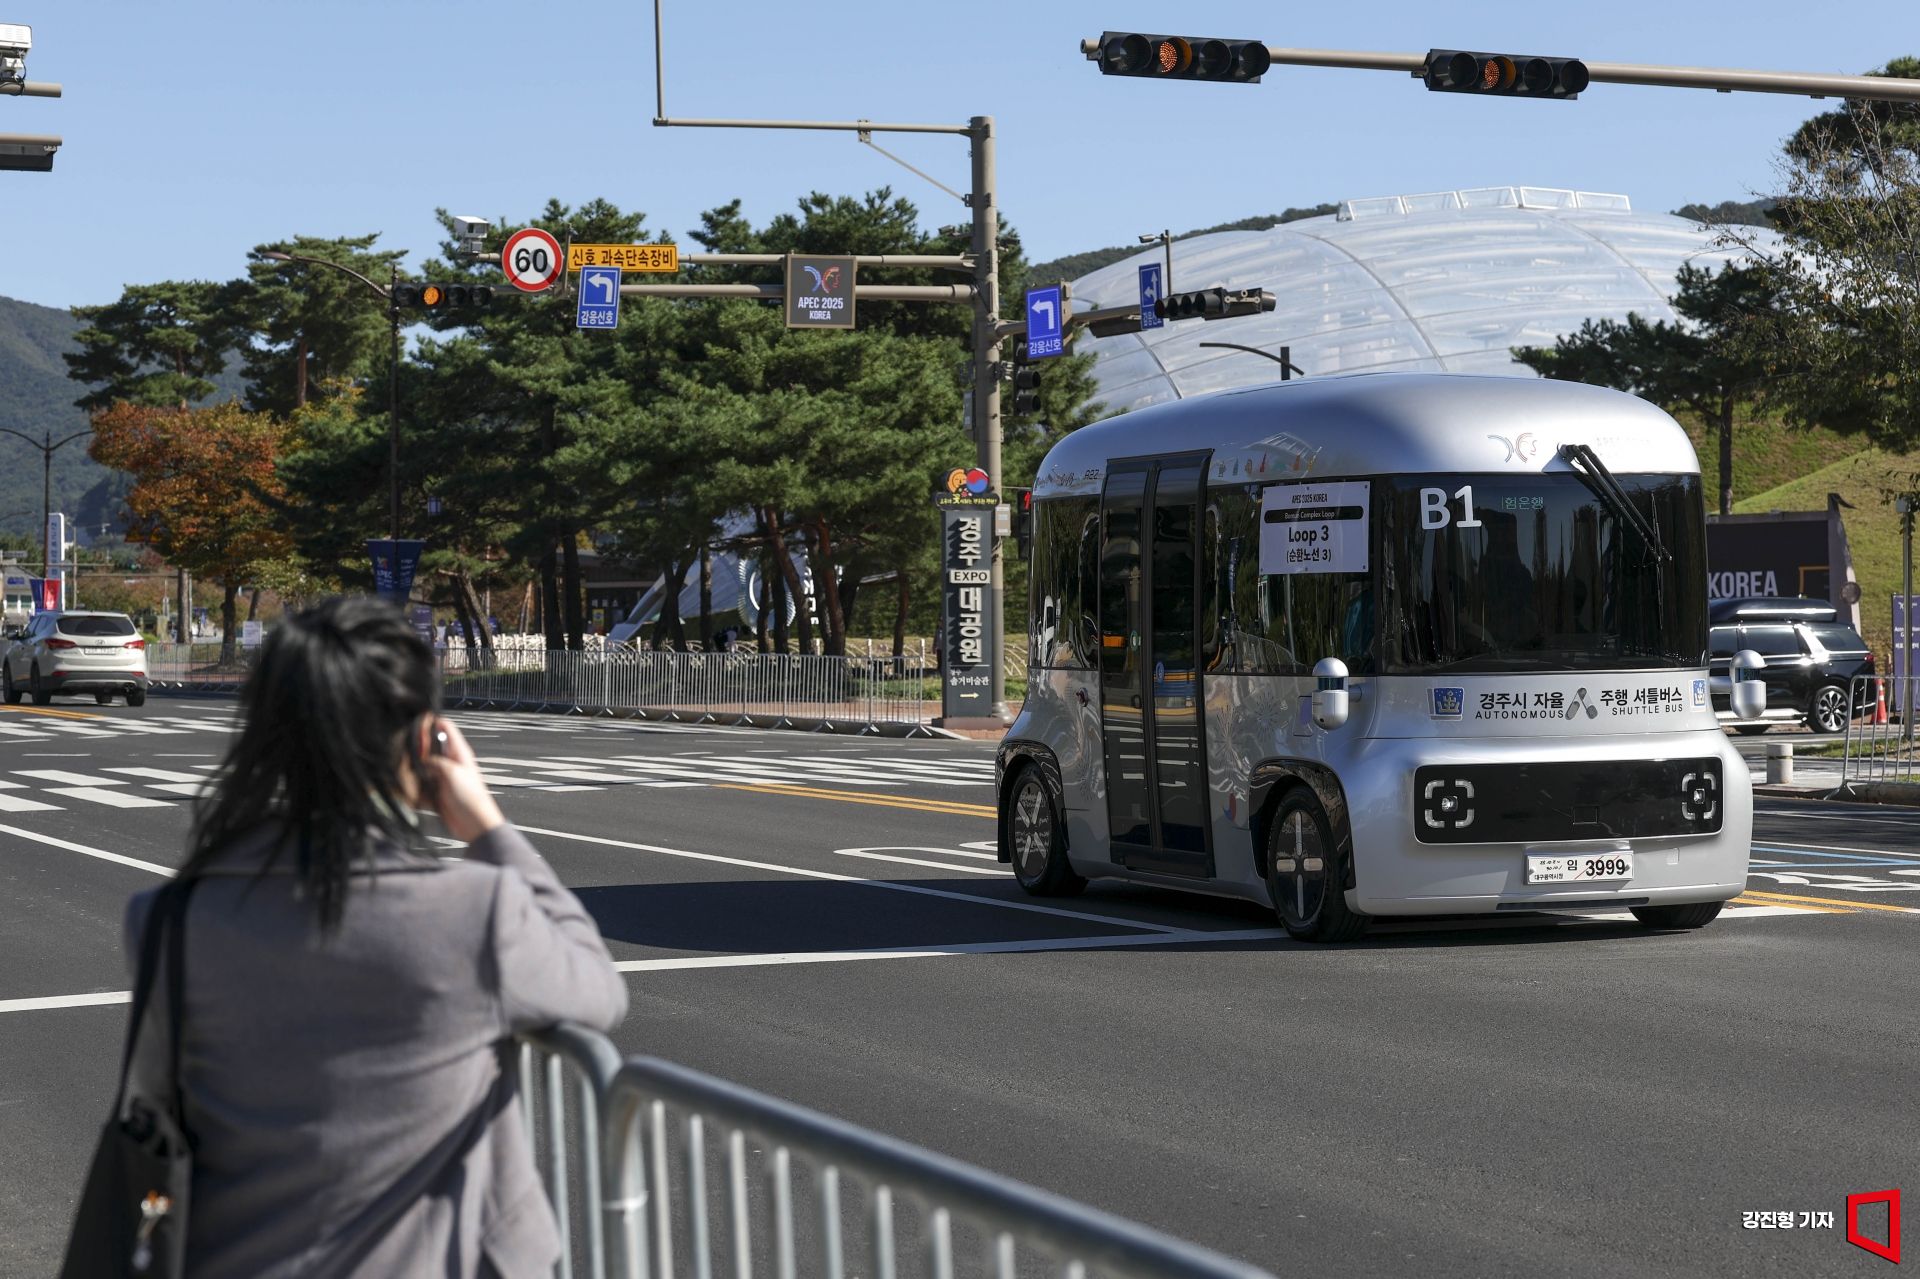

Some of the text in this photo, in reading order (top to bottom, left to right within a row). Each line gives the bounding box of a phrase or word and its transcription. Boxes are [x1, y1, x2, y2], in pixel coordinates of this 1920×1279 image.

[515, 248, 547, 272] 60
[573, 249, 673, 267] 신호 과속단속장비
[798, 297, 843, 309] APEC 2025
[581, 310, 613, 325] 감응신호
[809, 310, 831, 320] KOREA
[1030, 338, 1061, 354] 감응신호
[1313, 493, 1328, 503] KOREA
[1300, 509, 1321, 520] Complex
[1321, 510, 1335, 519] Loop
[1420, 485, 1482, 530] B1
[958, 517, 982, 566] 경주
[1288, 525, 1329, 547] Loop 3
[1286, 548, 1332, 563] (순환노선 3)
[954, 571, 987, 582] EXPO
[1708, 570, 1778, 598] KOREA
[959, 587, 982, 663] 대공원
[1480, 687, 1683, 710] 경주시 자율 주행 셔틀버스
[1475, 703, 1683, 720] AUTONOMOUS SHUTTLE BUS
[1567, 859, 1626, 876] 임 3999
